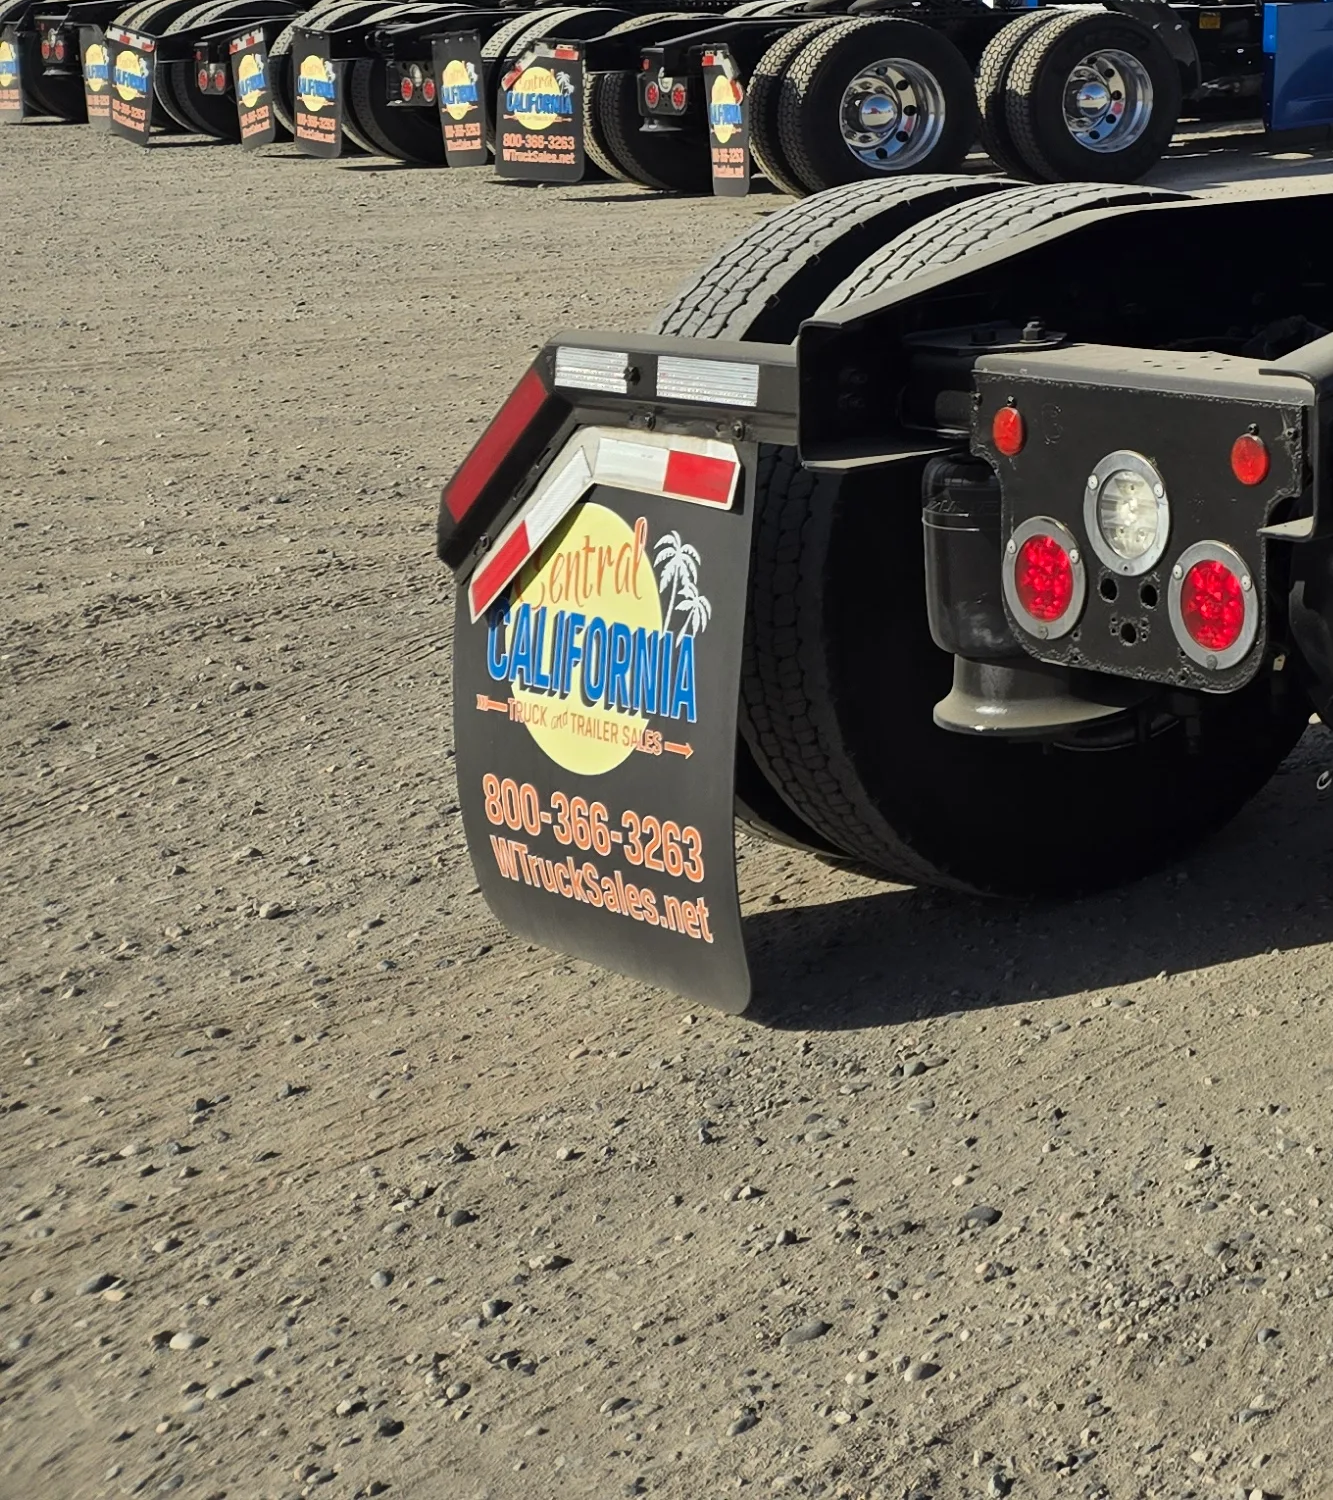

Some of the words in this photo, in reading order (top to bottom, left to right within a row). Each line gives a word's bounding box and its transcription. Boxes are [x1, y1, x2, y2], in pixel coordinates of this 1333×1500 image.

[506, 90, 574, 115] CALIFORNIA
[487, 597, 698, 723] CALIFORNIA
[507, 697, 548, 729] TRUCK
[551, 705, 568, 731] and
[570, 712, 619, 745] TRAILER
[622, 724, 664, 756] SALES
[482, 773, 705, 883] 800-366-3263
[489, 834, 714, 943] WTruckSales.net
